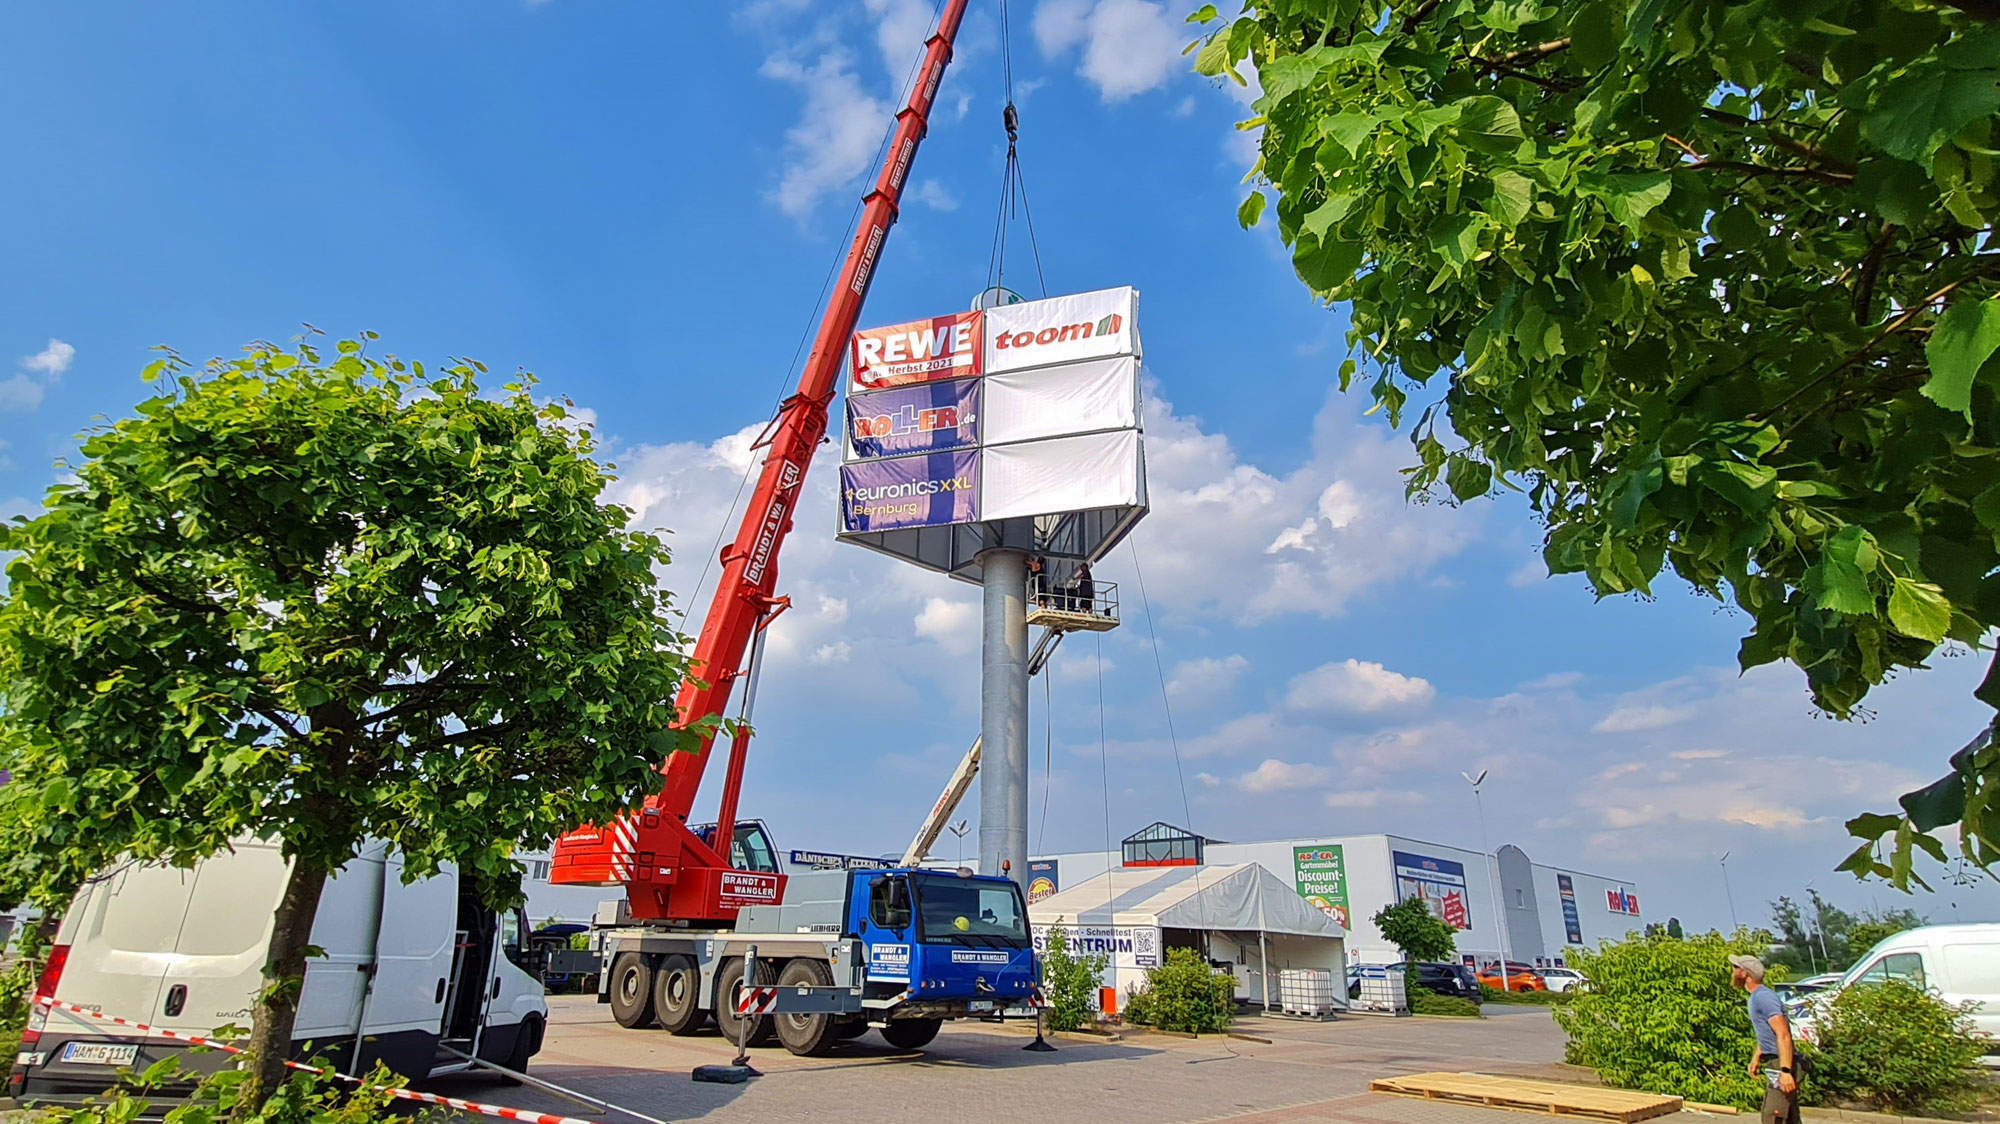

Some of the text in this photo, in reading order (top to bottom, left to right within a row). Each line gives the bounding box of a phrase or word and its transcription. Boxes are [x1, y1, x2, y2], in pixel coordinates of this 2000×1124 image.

[854, 265, 868, 292] BRANDT
[866, 228, 881, 259] WANGLER
[995, 321, 1094, 350] toom
[858, 321, 972, 369] REWE
[888, 363, 923, 375] Herbst
[926, 357, 953, 371] 2021
[853, 502, 918, 516] Bernburg
[748, 465, 796, 580] BRANDT & WALER
[724, 875, 759, 886] BRANDT
[1297, 869, 1343, 882] Discount-
[734, 886, 775, 898] WANGLER
[1304, 881, 1339, 894] Preise!
[1605, 885, 1640, 914] ROLLER
[810, 924, 841, 933] LIEBHERR
[1086, 928, 1131, 936] Schnelltest
[873, 946, 897, 954] BRANDT
[953, 953, 976, 961] BRANDT
[981, 954, 1008, 962] WANGLER
[71, 1044, 134, 1060] HAM G 1114
